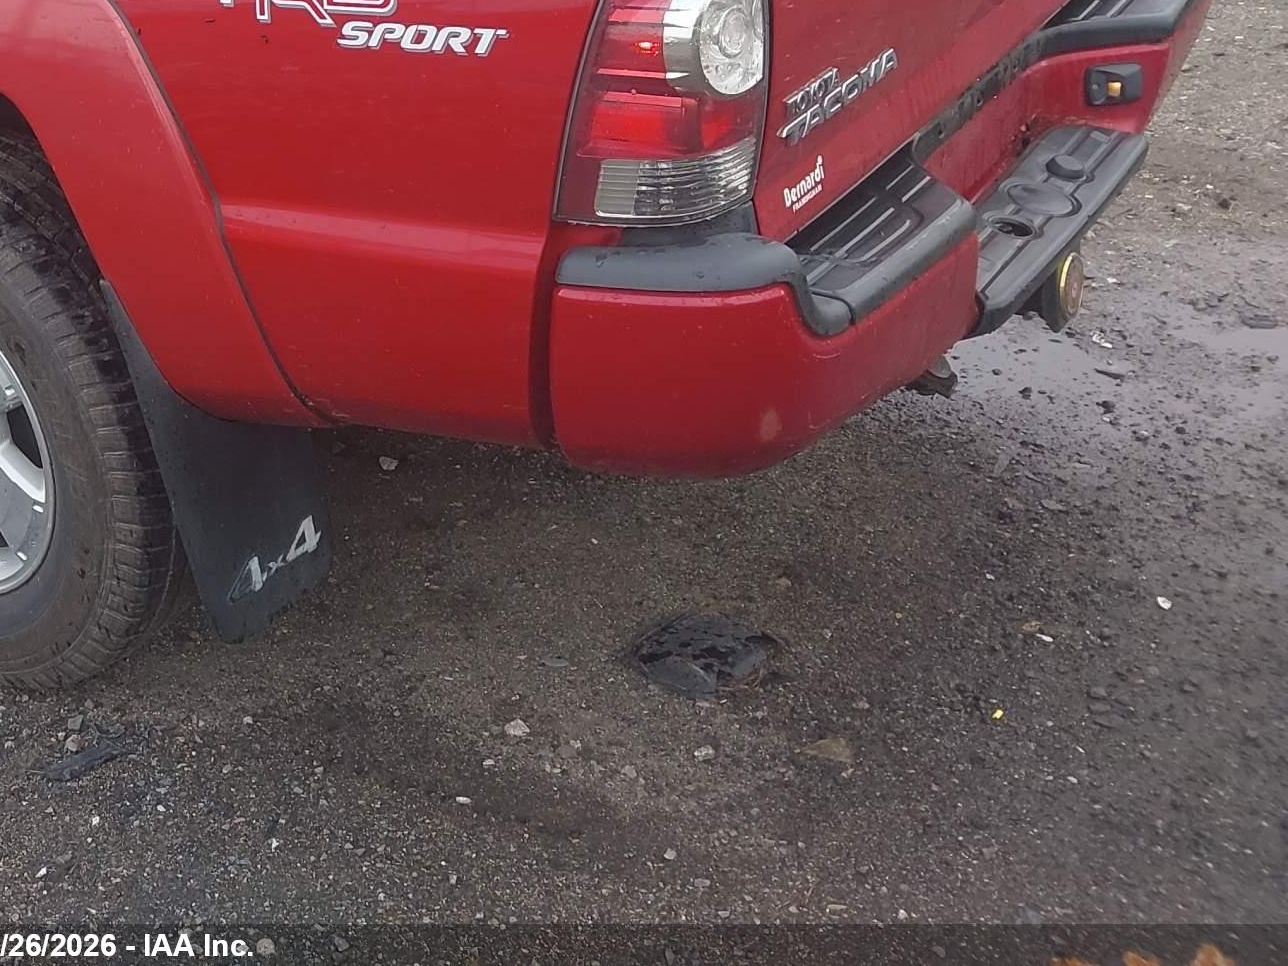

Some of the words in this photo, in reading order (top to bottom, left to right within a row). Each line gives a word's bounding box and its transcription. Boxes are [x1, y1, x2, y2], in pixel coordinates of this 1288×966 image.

[337, 20, 509, 56] SPORT
[777, 48, 897, 146] TACOMA
[783, 67, 841, 114] TOYOTA
[784, 155, 825, 208] Bernardi
[227, 514, 322, 603] 4x4
